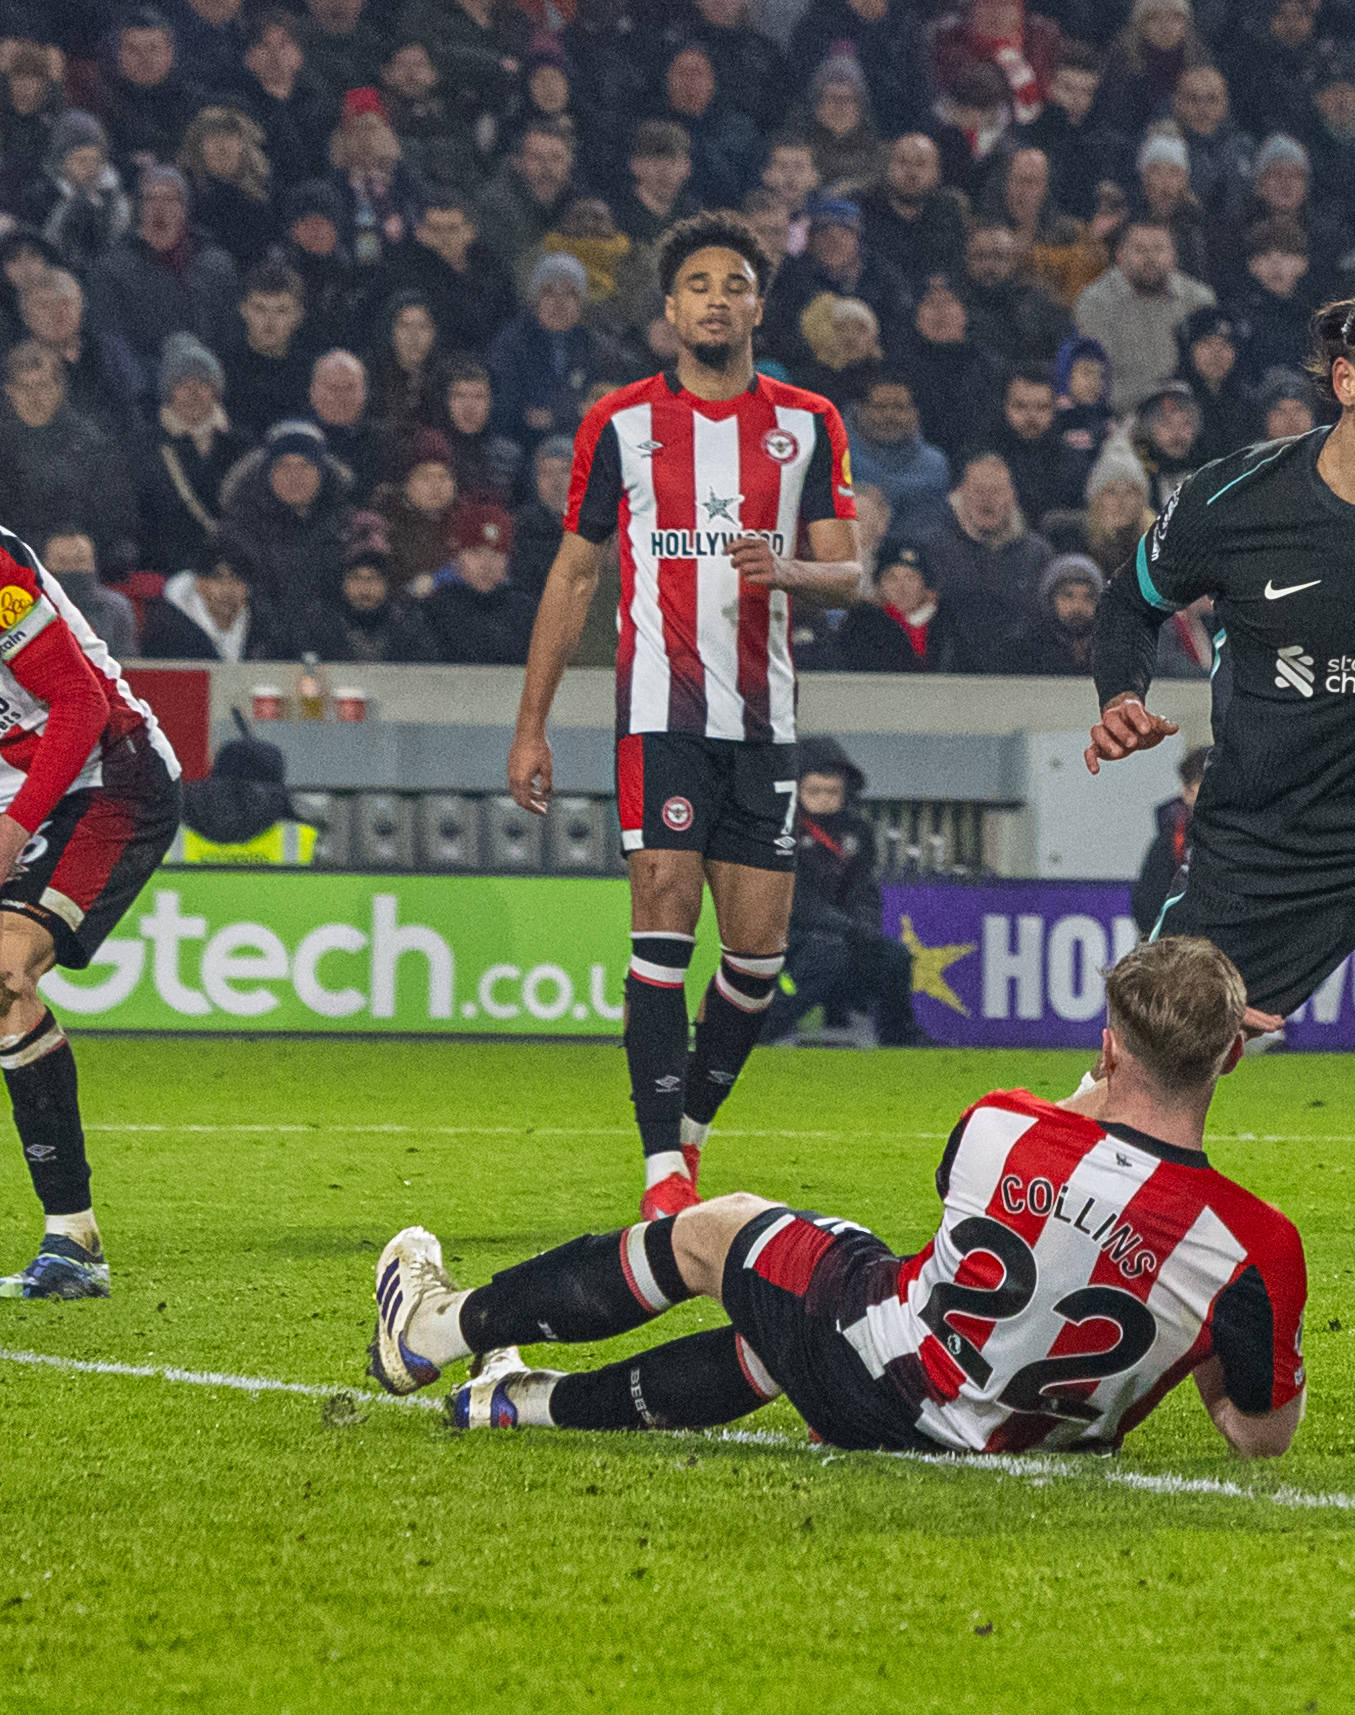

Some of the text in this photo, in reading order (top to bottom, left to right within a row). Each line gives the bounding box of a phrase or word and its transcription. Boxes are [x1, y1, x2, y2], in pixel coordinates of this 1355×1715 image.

[651, 531, 784, 556] HOLLYD
[773, 780, 798, 835] 7
[38, 890, 625, 1019] Gtech.co.u
[1001, 1174, 1157, 1279] COLLINS
[917, 1216, 1157, 1422] 22
